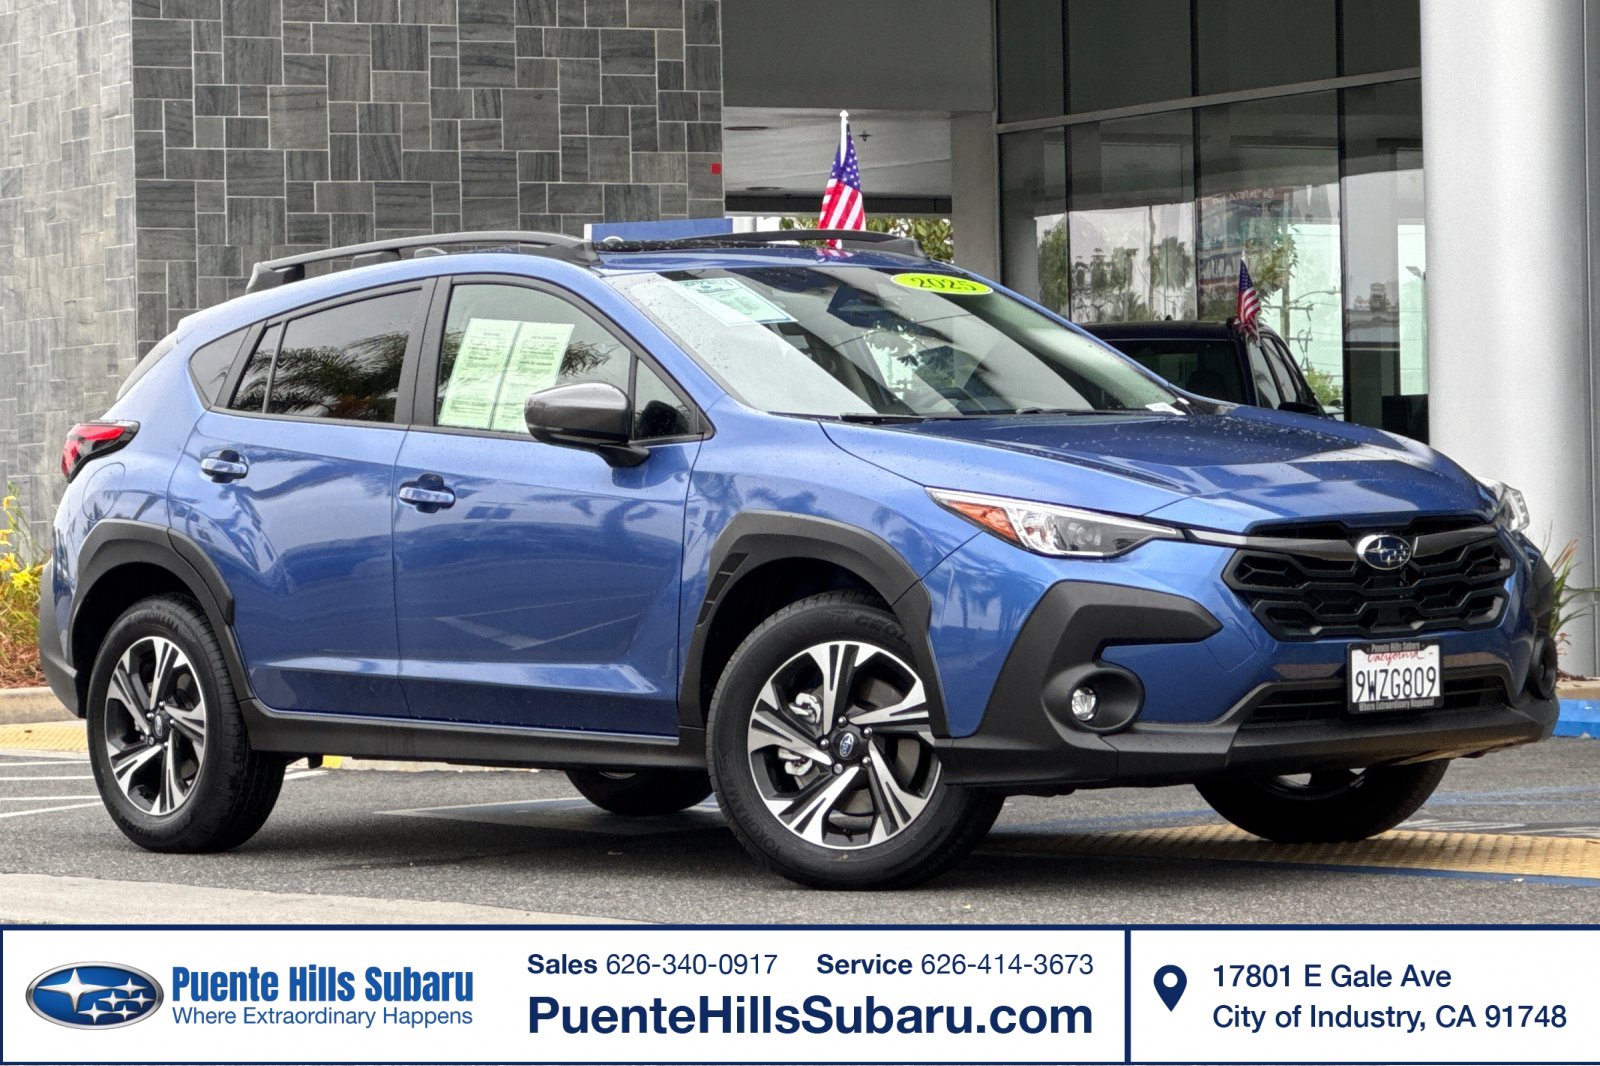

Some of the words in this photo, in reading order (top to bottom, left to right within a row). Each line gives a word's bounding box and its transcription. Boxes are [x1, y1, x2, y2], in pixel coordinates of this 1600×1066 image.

[911, 277, 977, 291] 2025
[1368, 651, 1424, 666] California
[1355, 666, 1436, 702] 9WZG809
